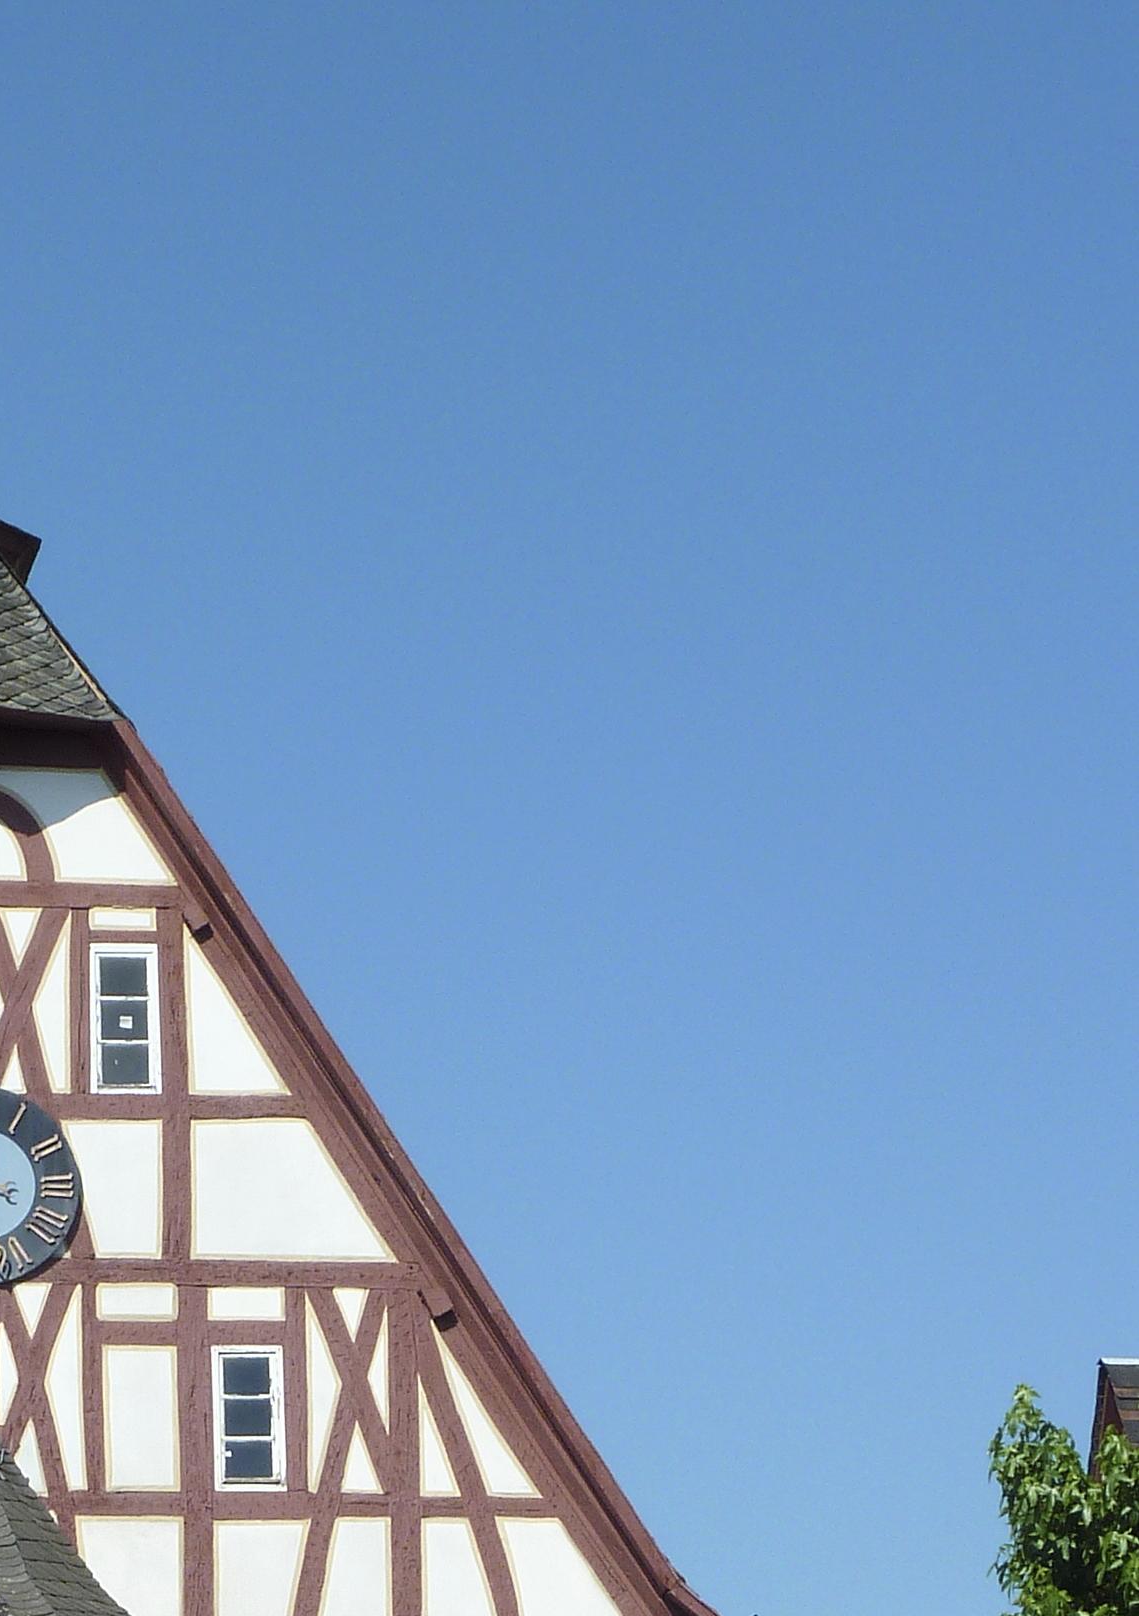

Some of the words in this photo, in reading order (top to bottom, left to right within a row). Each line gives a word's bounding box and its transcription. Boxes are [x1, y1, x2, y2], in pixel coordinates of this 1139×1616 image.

[9, 1101, 27, 1135] I
[30, 1133, 63, 1162] II
[41, 1171, 74, 1199] III
